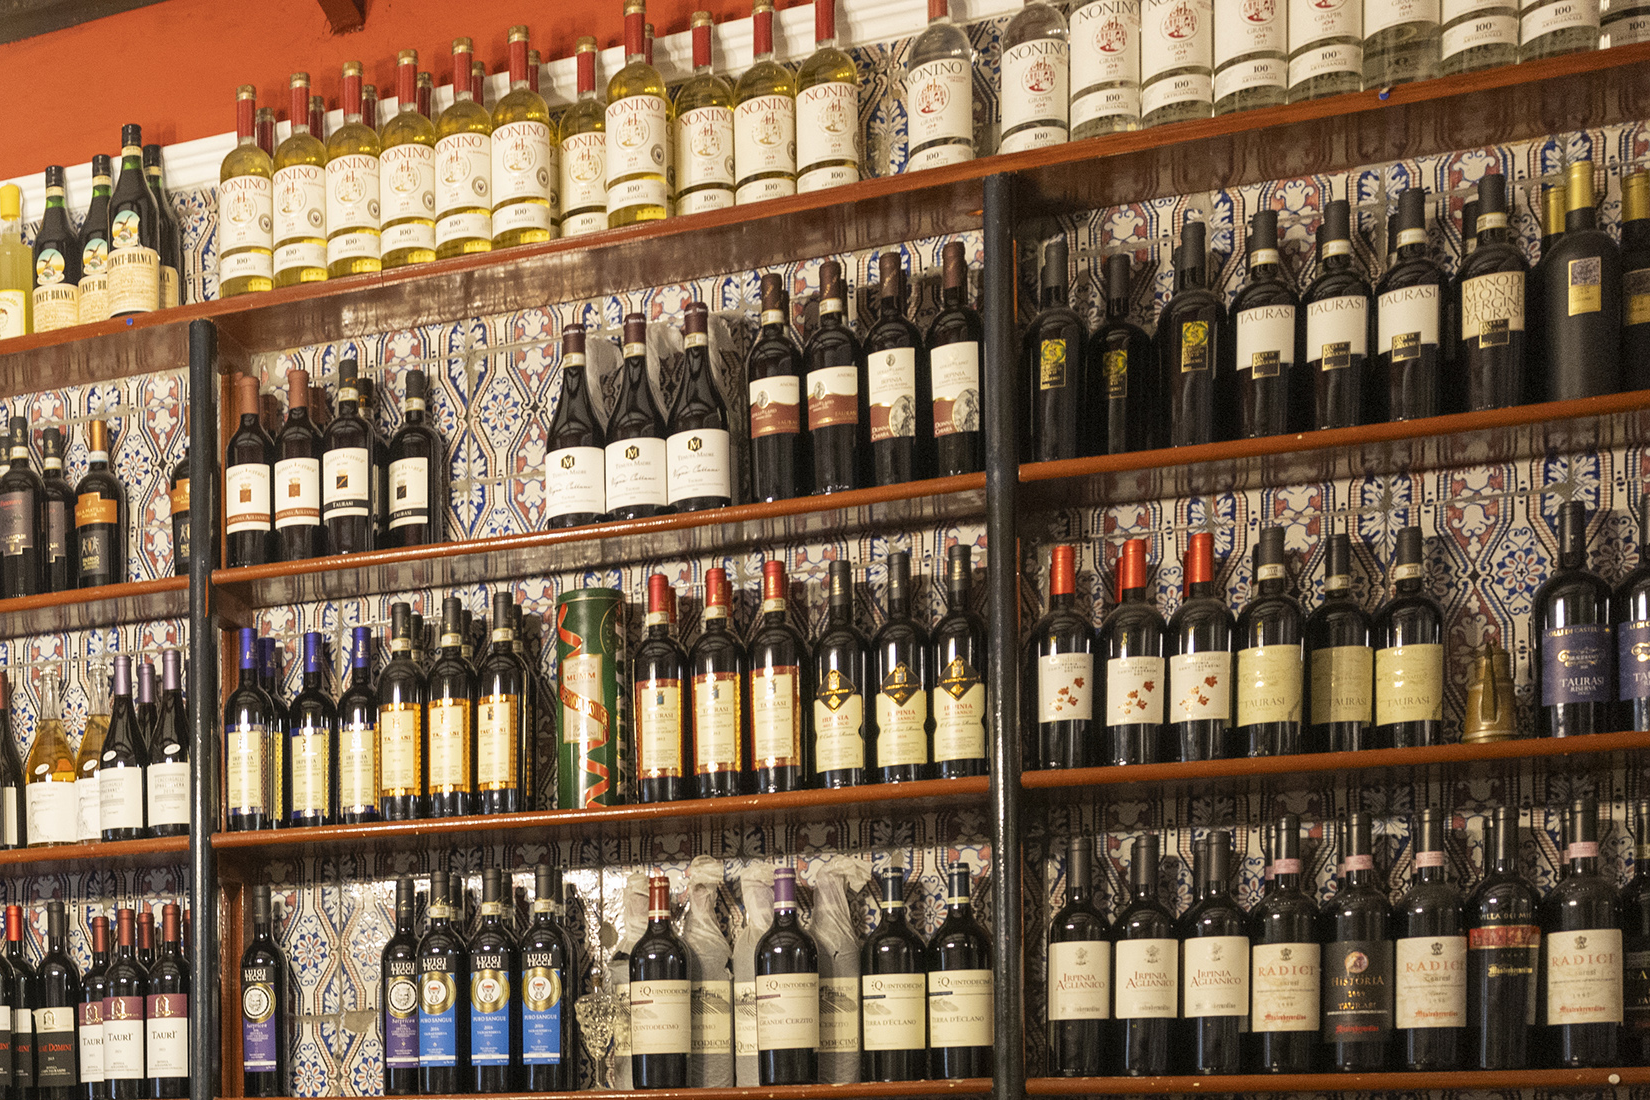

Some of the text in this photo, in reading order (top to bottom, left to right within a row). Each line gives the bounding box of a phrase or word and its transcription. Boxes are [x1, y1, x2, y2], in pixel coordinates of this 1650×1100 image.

[1009, 43, 1067, 64] NONINO
[908, 61, 963, 89] NONINO
[607, 98, 661, 121] NONINO
[494, 123, 548, 142] NONINO
[1464, 275, 1505, 294] PIANO
[1380, 286, 1437, 308] TAURASI
[1309, 297, 1366, 317] TAURASI
[1238, 305, 1295, 325] TAURASI
[1464, 307, 1524, 326] TAURASI
[332, 499, 354, 508] TAURASI
[393, 509, 412, 518] TAURASI
[1545, 628, 1564, 638] COLLI
[566, 671, 596, 681] MUMM
[1560, 676, 1605, 688] TAURASI
[1244, 697, 1285, 709] TAURASI
[1329, 696, 1366, 707] TAURASI
[1388, 696, 1430, 708] TAURASI
[1479, 912, 1501, 922] VILLA
[422, 957, 447, 966] LUIGI
[476, 955, 501, 964] LUIGI
[527, 953, 552, 962] LUIGI
[527, 959, 552, 967] TECCE
[1551, 953, 1615, 968] RADICI
[390, 962, 415, 970] LUIGI
[423, 963, 447, 971] TECCE
[476, 961, 501, 969] TECCE
[1406, 960, 1466, 973] RADICI
[244, 968, 266, 976] LUIGI
[1134, 970, 1168, 981] IRPINIA
[1197, 968, 1232, 979] IRPINIA
[1258, 965, 1315, 977] RADICI
[244, 974, 267, 982] TECCE
[1063, 972, 1097, 982] IRPINIA
[1190, 976, 1242, 988] AGLIANICO
[1055, 979, 1105, 991] AGLIANICO
[1125, 977, 1175, 989] AGLIANICO
[785, 1016, 814, 1025] CERZITO
[49, 1043, 72, 1052] DOMINI
